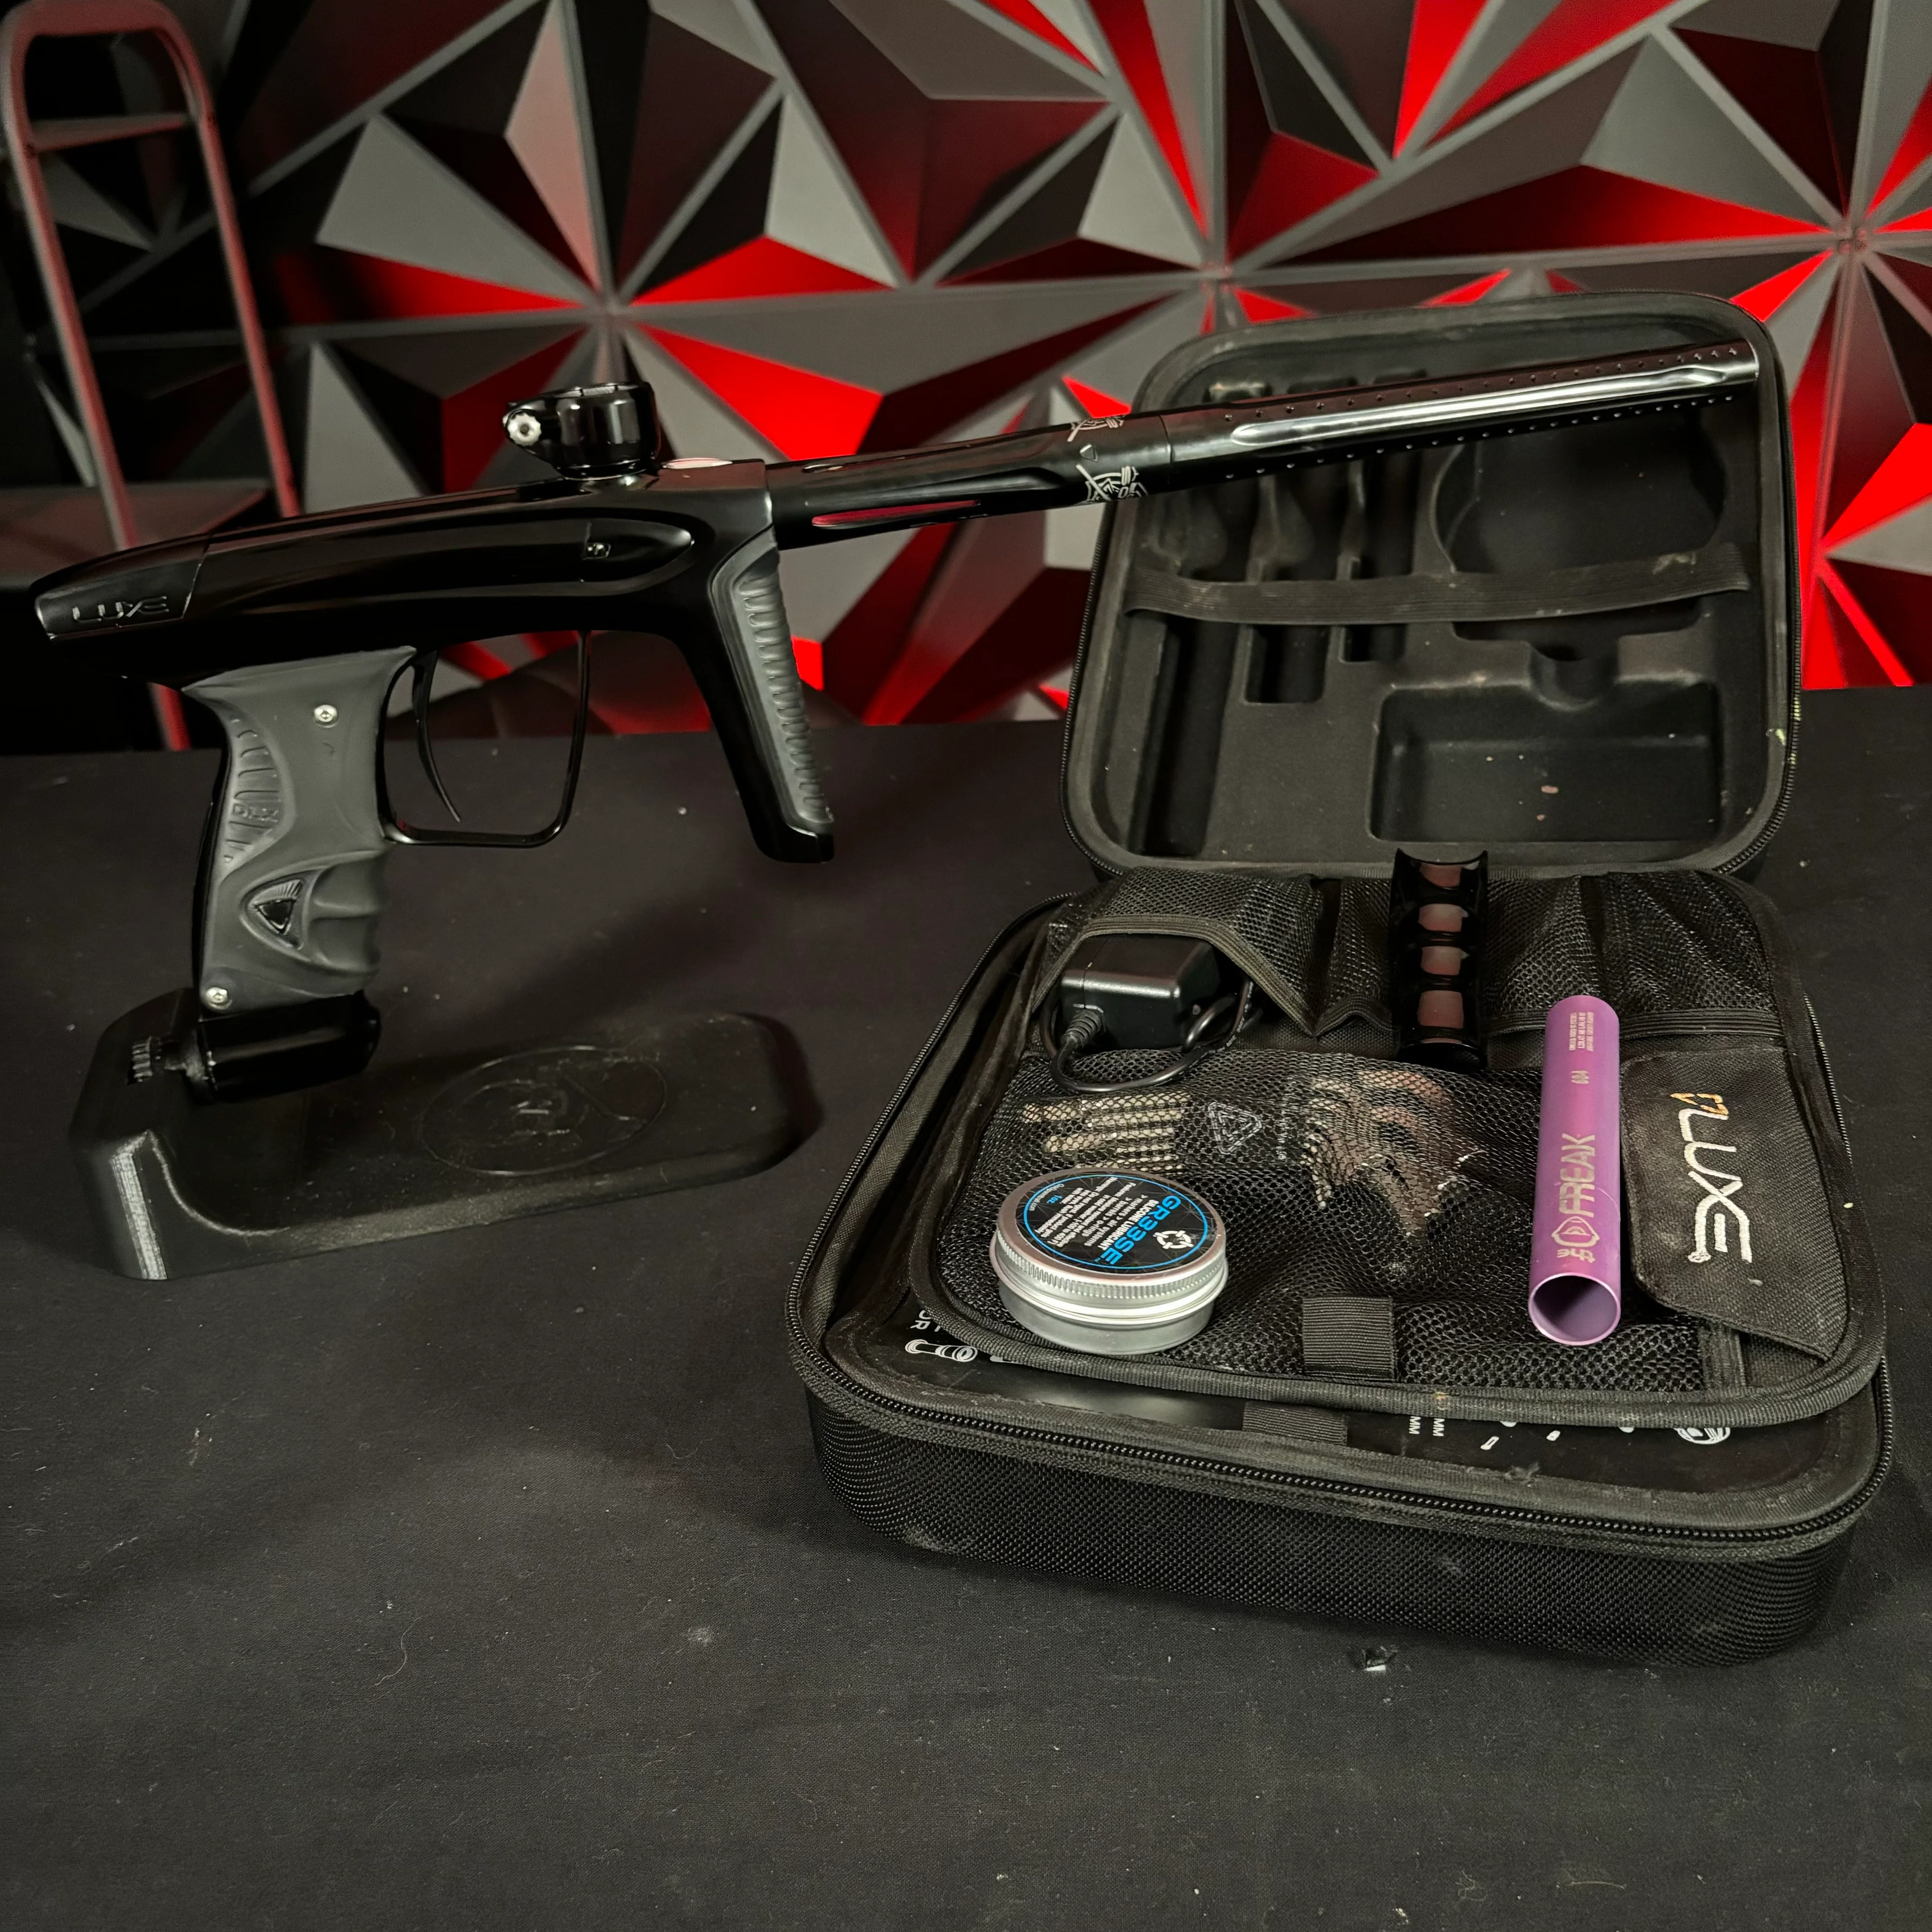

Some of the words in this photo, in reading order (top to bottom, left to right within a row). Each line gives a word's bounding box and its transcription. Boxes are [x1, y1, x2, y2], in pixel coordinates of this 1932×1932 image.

[73, 596, 169, 623] LUXE
[1559, 1133, 1595, 1218] FREAK
[1087, 1191, 1100, 1199] Do
[1679, 1109, 1753, 1263] LUXE
[1104, 1200, 1129, 1218] barrels
[1118, 1197, 1145, 1217] markers
[1127, 1198, 1160, 1222] SILICONE
[1072, 1224, 1086, 1233] and
[1079, 1219, 1106, 1237] o-rings
[1105, 1219, 1120, 1228] air
[1053, 1231, 1068, 1241] 400
[1082, 1225, 1111, 1247] systems
[1095, 1220, 1135, 1250] LUBRICANT
